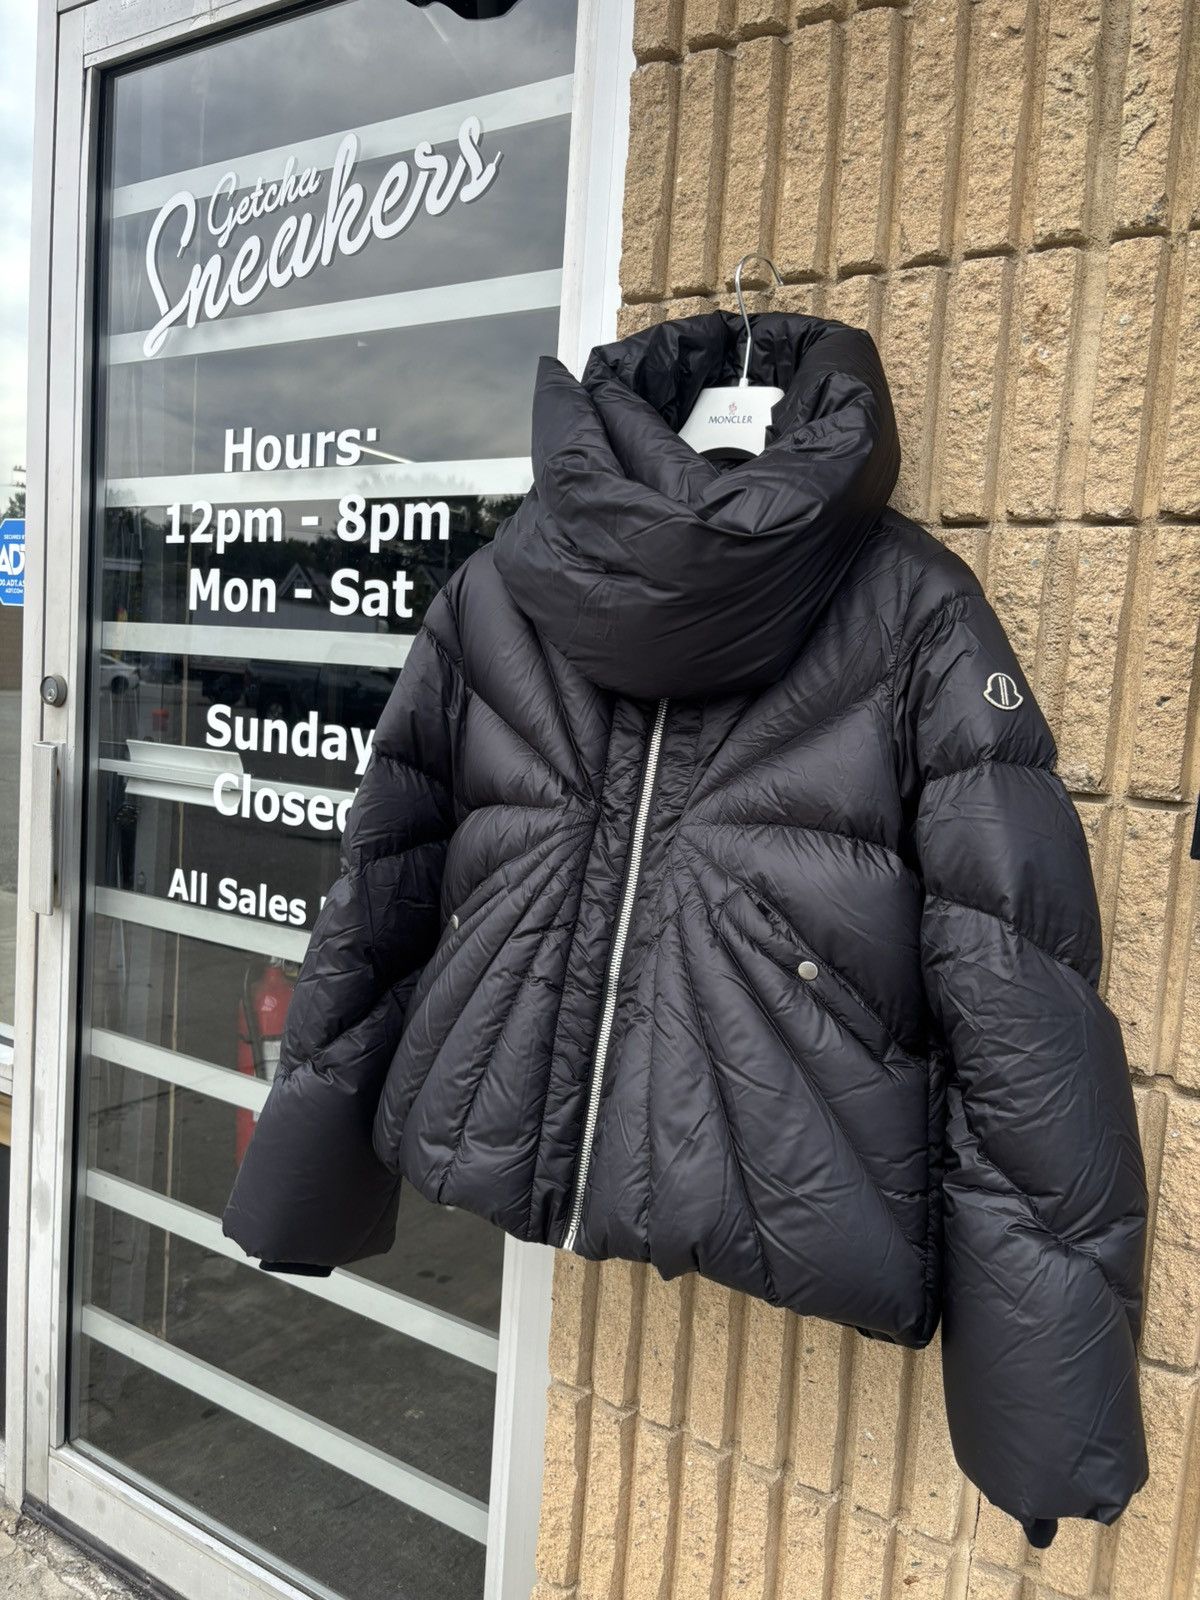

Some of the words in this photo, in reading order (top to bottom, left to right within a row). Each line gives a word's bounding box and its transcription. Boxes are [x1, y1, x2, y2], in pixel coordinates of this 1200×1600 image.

[207, 155, 322, 247] Getcha
[143, 115, 502, 358] Sneakers
[708, 415, 753, 424] MONCLER
[165, 502, 283, 554] 12pm
[301, 516, 319, 526] -
[336, 494, 450, 553] 8pm
[188, 568, 277, 613] Mon
[294, 588, 312, 599] -
[329, 568, 414, 618] Sat
[205, 703, 377, 776] Sunday
[167, 867, 208, 906] All
[217, 876, 307, 925] Sales
